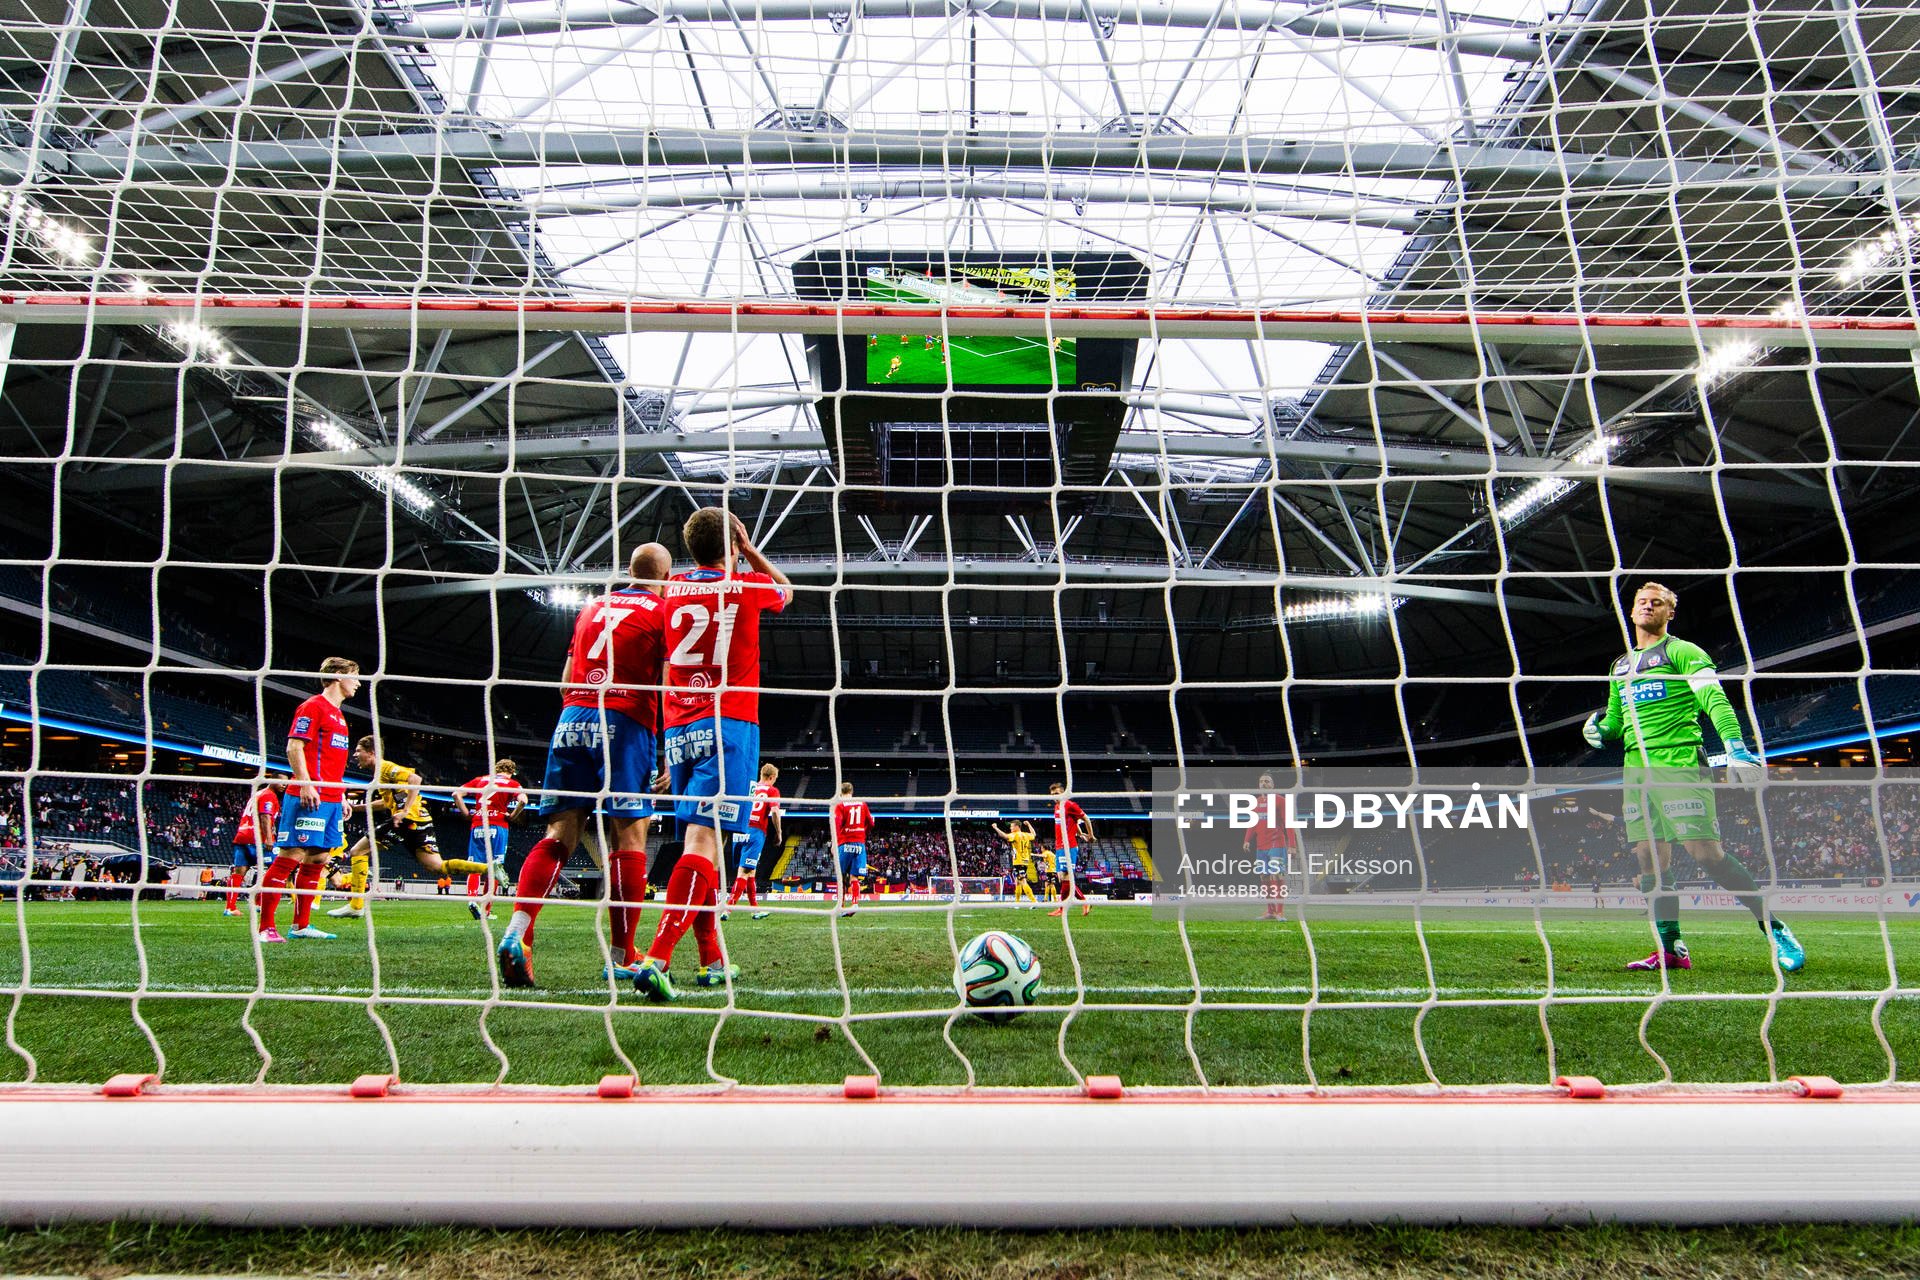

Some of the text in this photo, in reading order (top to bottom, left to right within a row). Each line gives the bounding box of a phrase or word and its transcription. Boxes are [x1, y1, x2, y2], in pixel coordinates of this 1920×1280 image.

[587, 607, 635, 659] 7
[670, 603, 740, 665] 21
[202, 744, 264, 767] NATIONALSPORTE
[849, 806, 862, 825] 11
[1780, 895, 1809, 905] SPORT
[1811, 895, 1826, 904] TO
[1828, 895, 1849, 905] THE
